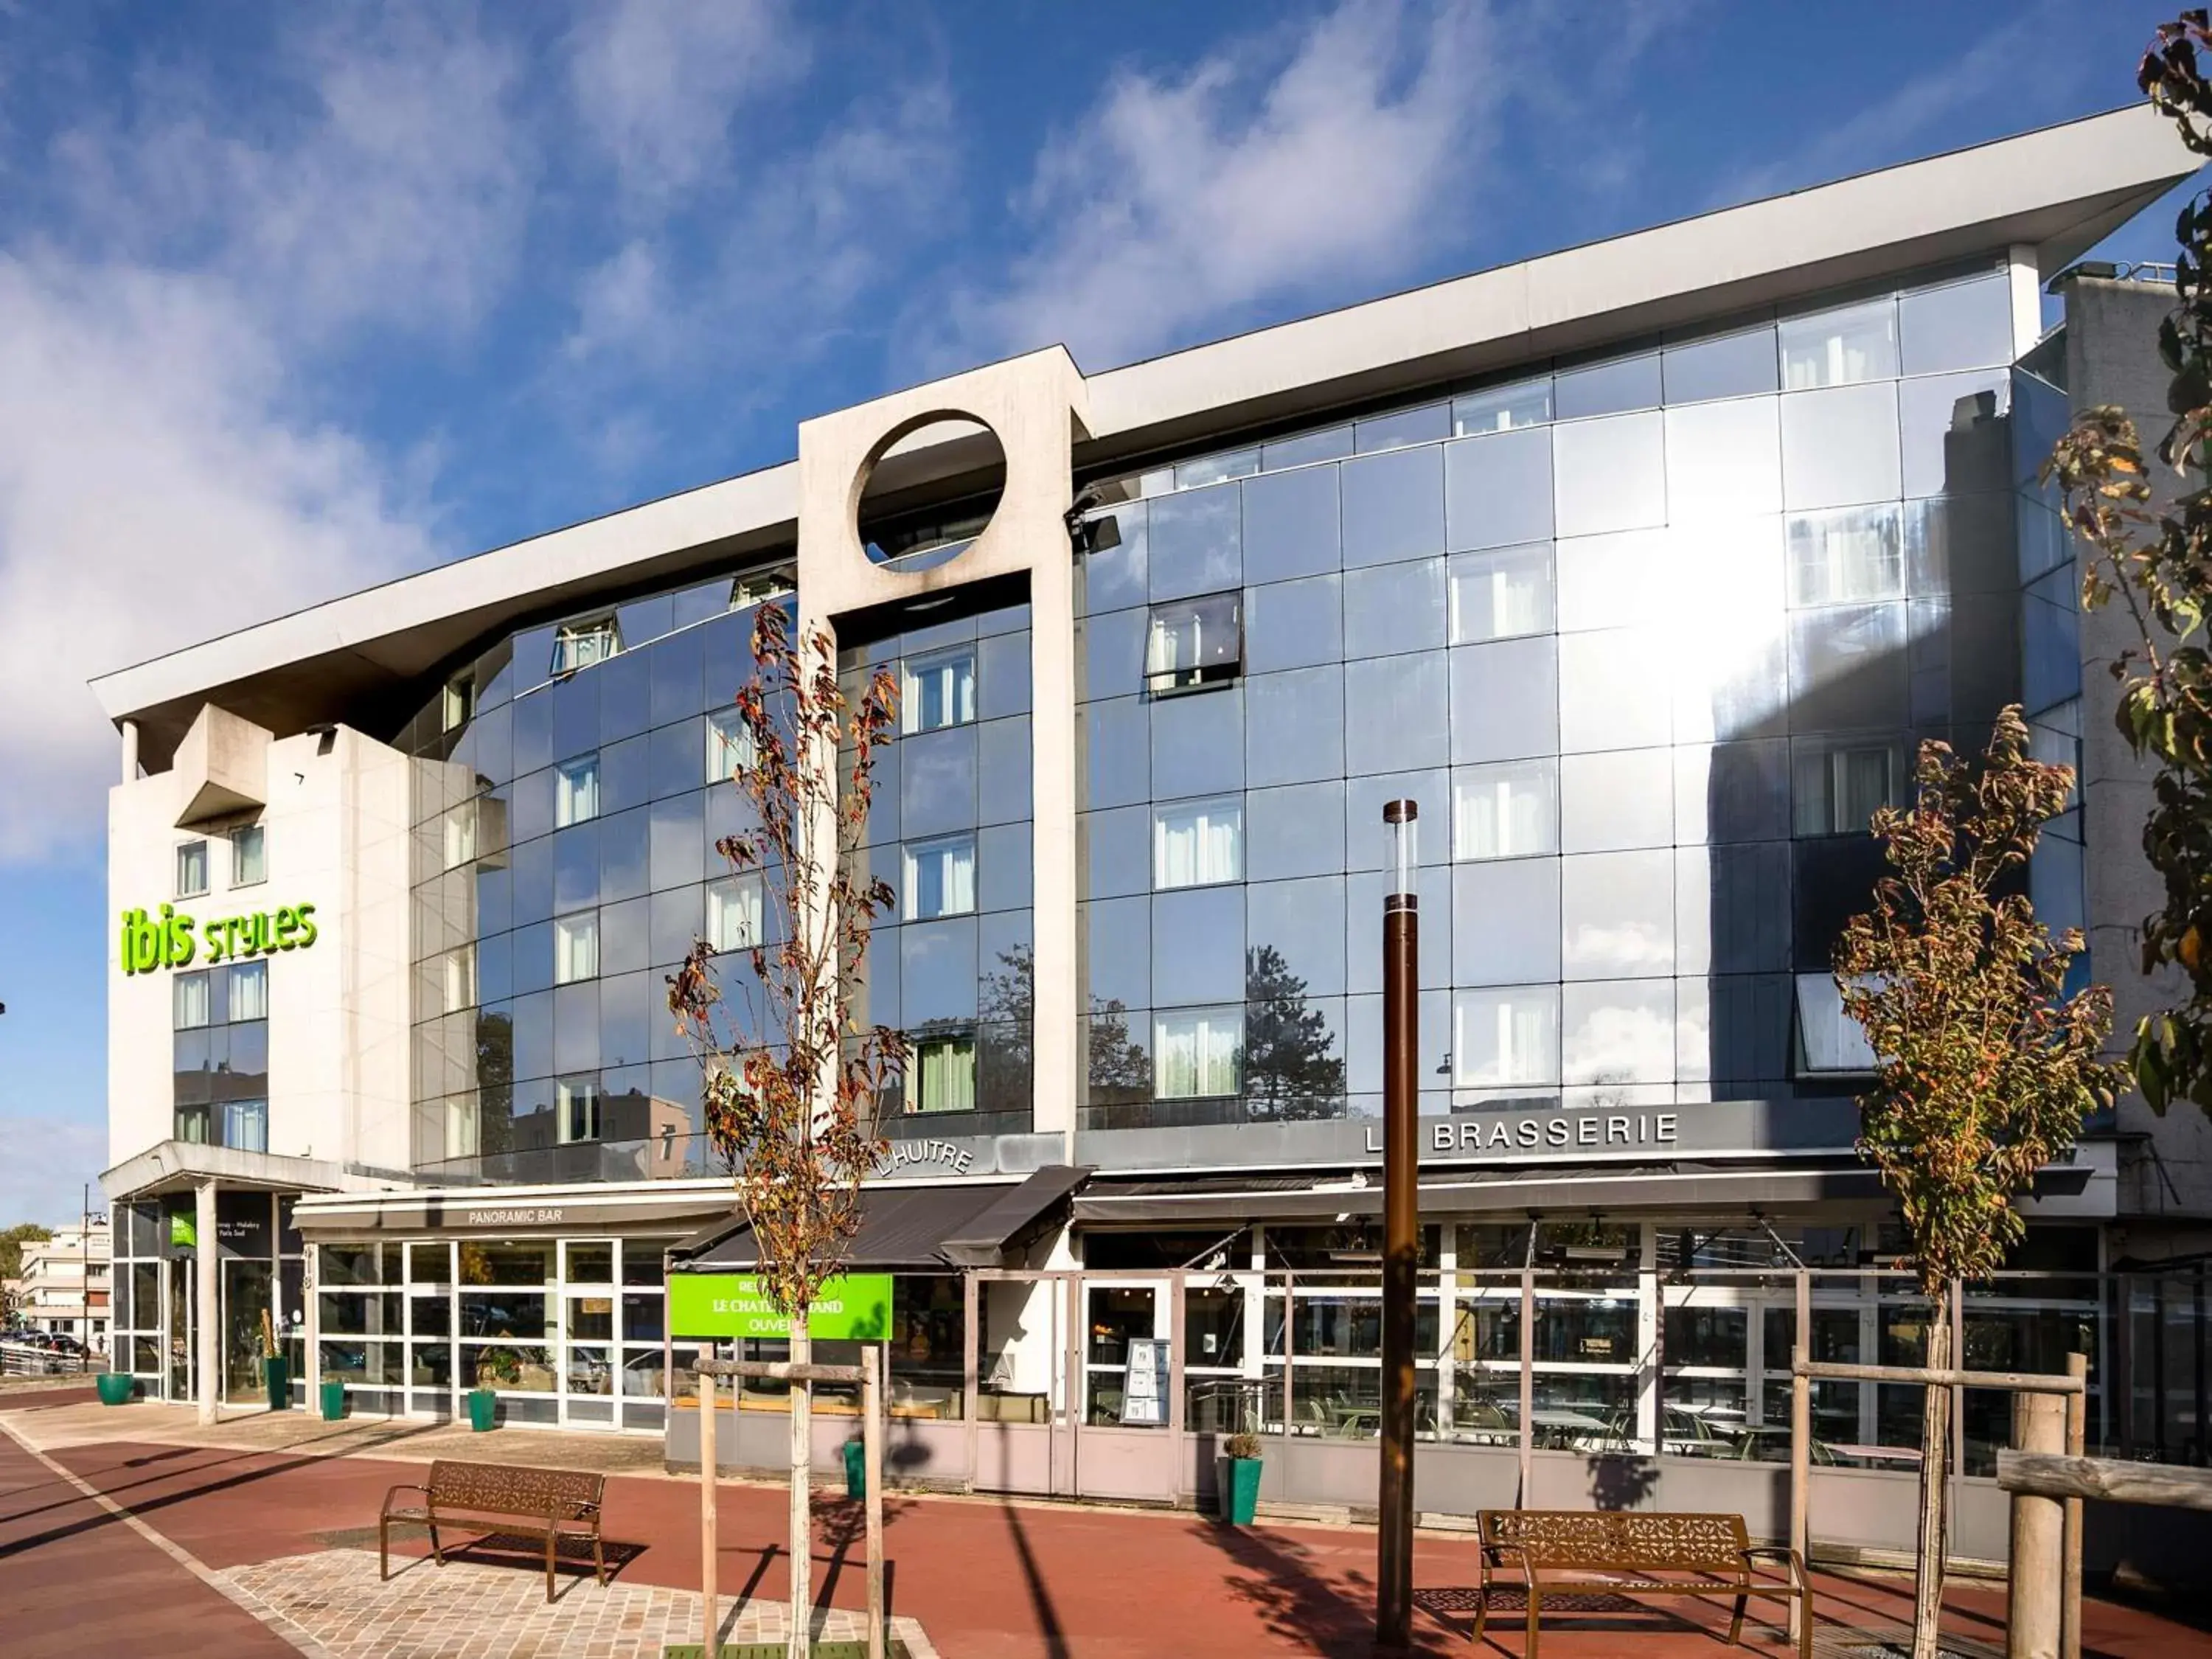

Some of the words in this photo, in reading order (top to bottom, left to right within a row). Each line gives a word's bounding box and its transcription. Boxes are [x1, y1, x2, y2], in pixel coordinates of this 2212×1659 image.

[121, 902, 196, 976] ibis
[1366, 1127, 1384, 1152] L
[1433, 1113, 1678, 1151] BRASSERIE
[468, 1209, 535, 1225] PANORAMIC
[538, 1209, 562, 1222] BAR
[713, 1300, 728, 1312] LE
